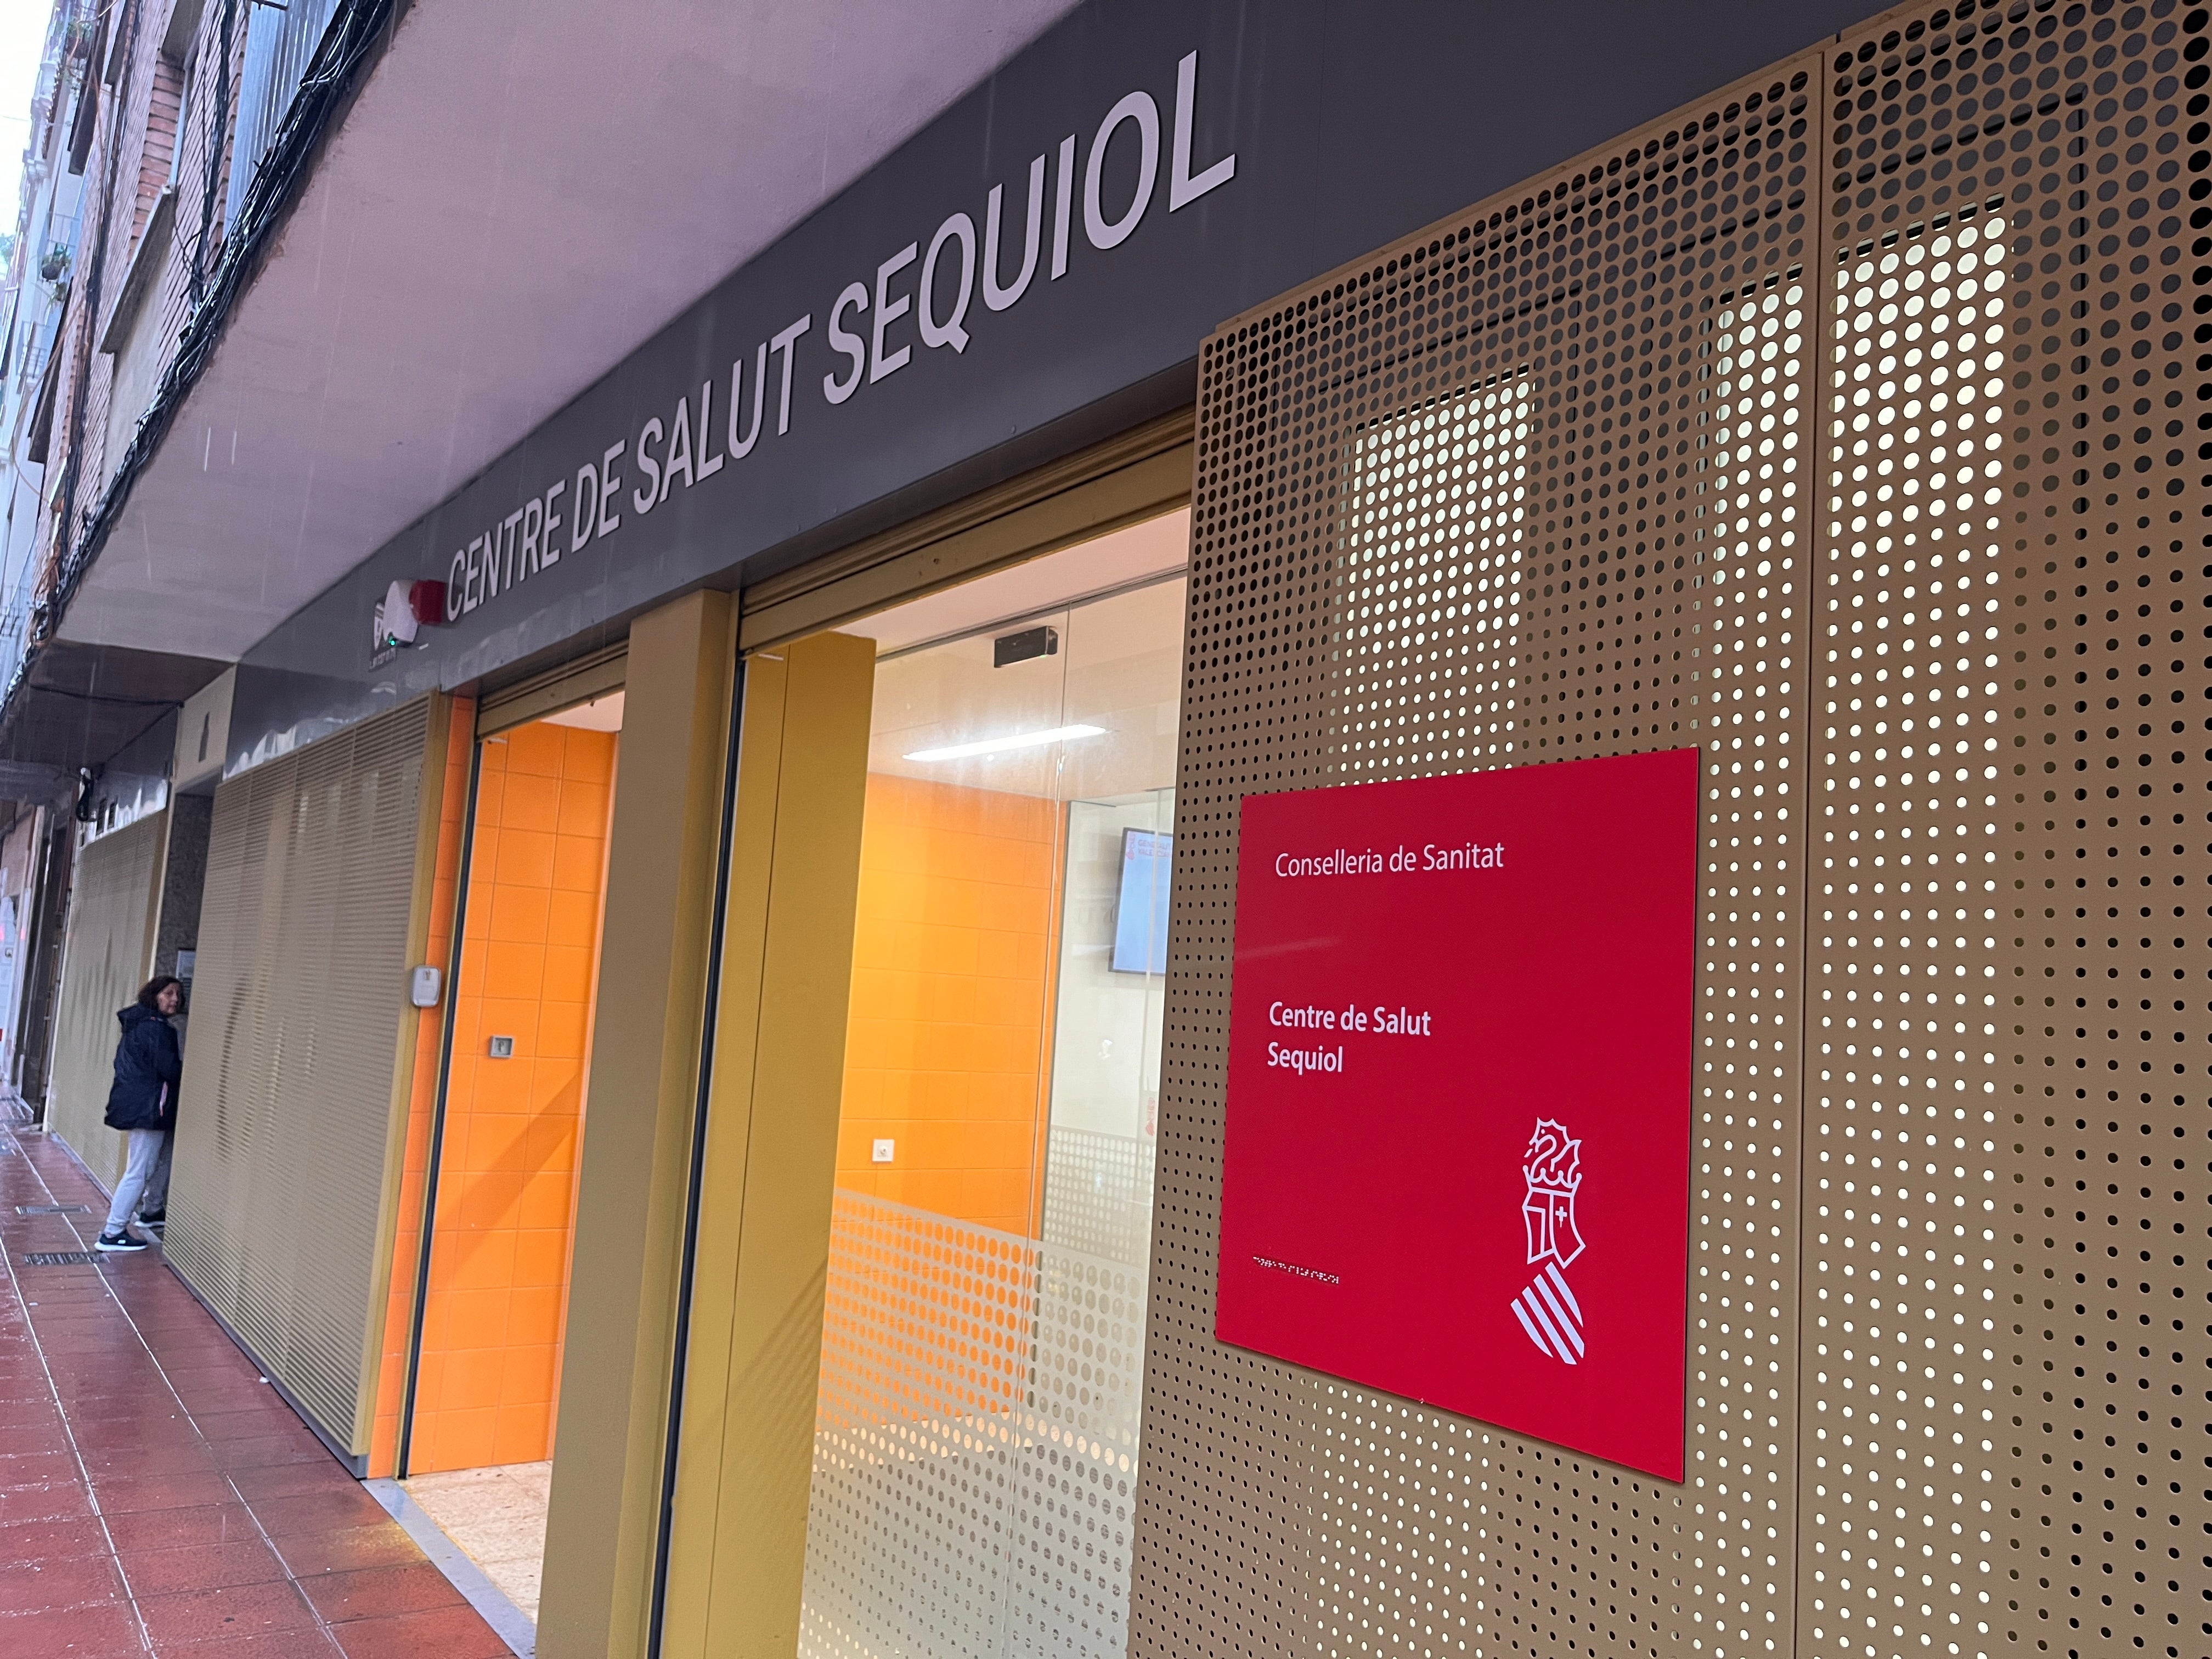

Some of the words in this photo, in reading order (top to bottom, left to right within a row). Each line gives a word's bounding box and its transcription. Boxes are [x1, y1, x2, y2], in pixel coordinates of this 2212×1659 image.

[445, 481, 565, 622] CENTRE
[572, 440, 624, 552] DE
[634, 315, 810, 514] SALUT
[823, 50, 1235, 404] SEQUIOL
[1276, 849, 1383, 877] Conselleria
[1389, 845, 1417, 872] de
[1423, 842, 1504, 871] Sanitat
[1269, 1001, 1335, 1029] Centre
[1340, 1004, 1367, 1031] de
[1373, 1006, 1431, 1036] Salut
[1267, 1042, 1343, 1075] Sequiol
